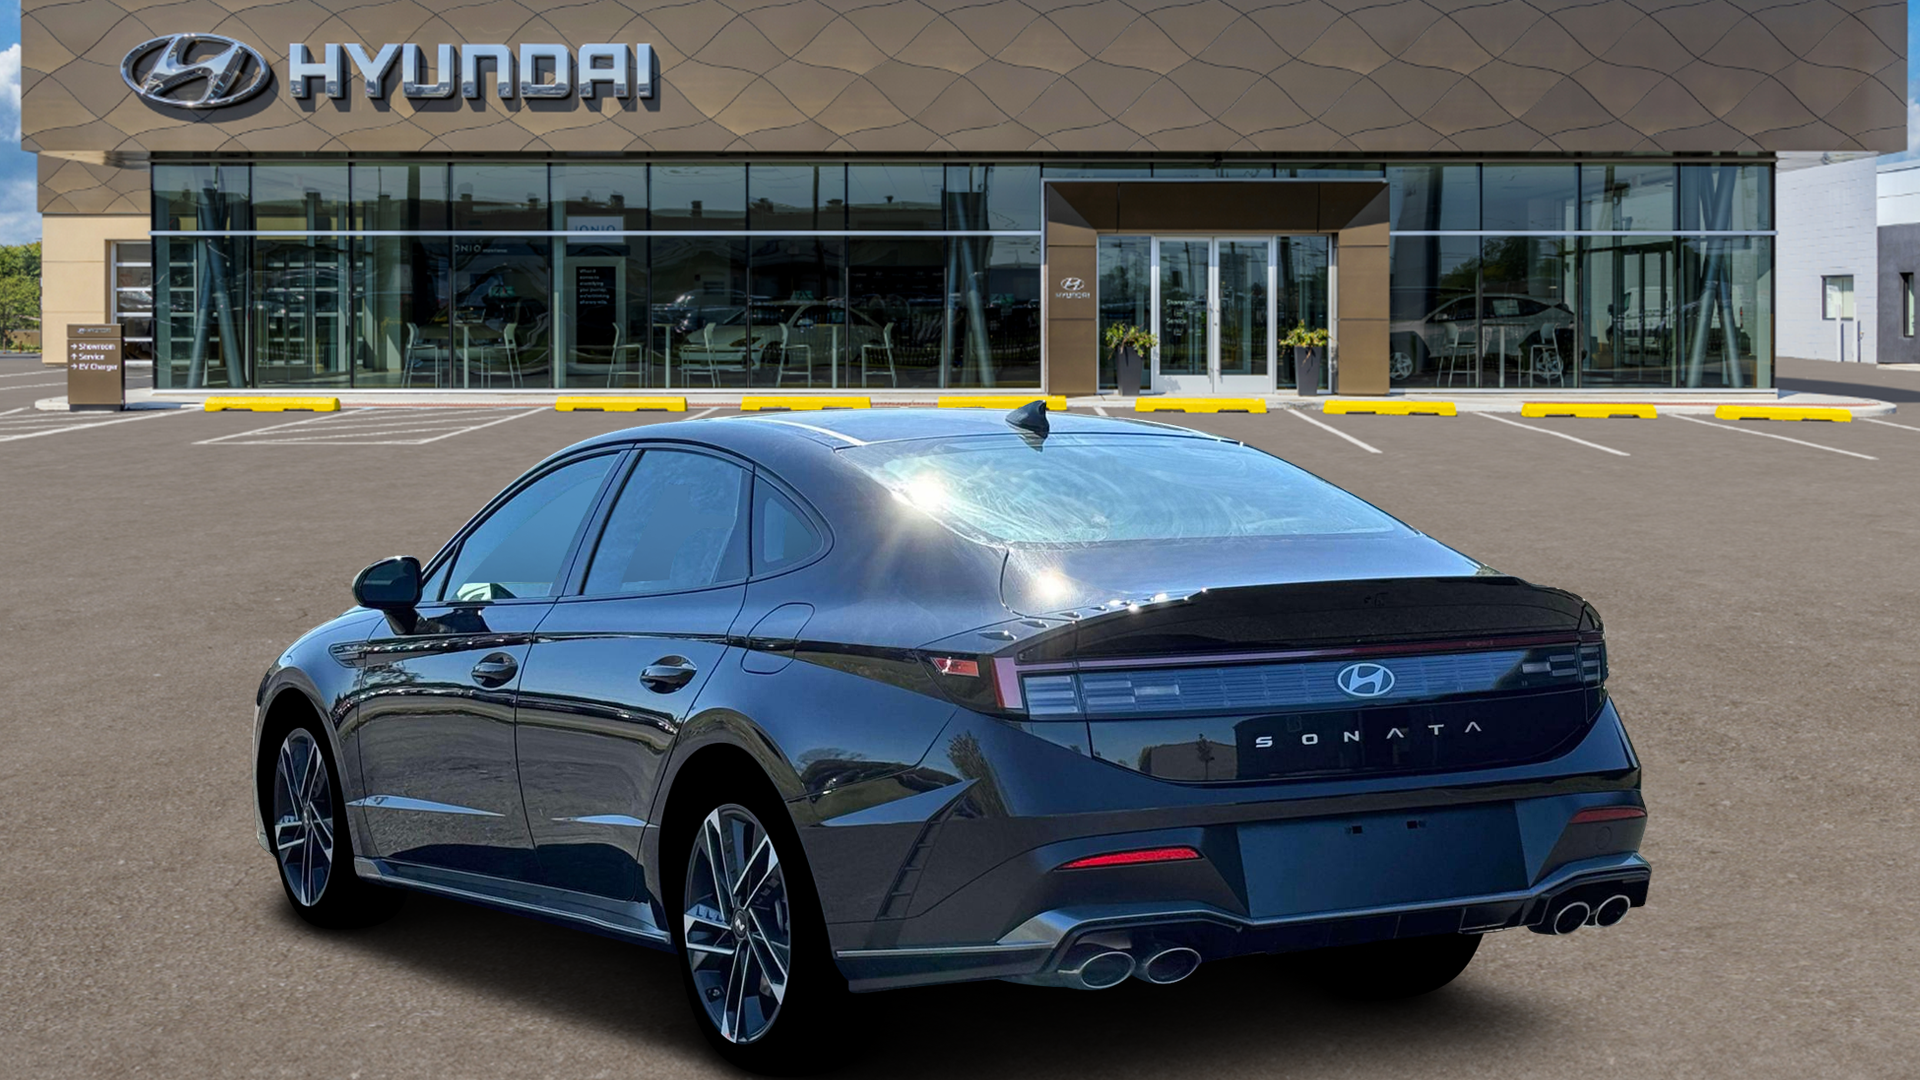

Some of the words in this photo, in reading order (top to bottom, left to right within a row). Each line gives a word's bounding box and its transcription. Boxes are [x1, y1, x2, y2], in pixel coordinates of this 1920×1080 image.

[289, 43, 656, 99] HYUNDAI
[90, 363, 118, 372] Charger
[1255, 720, 1482, 748] SONATA
